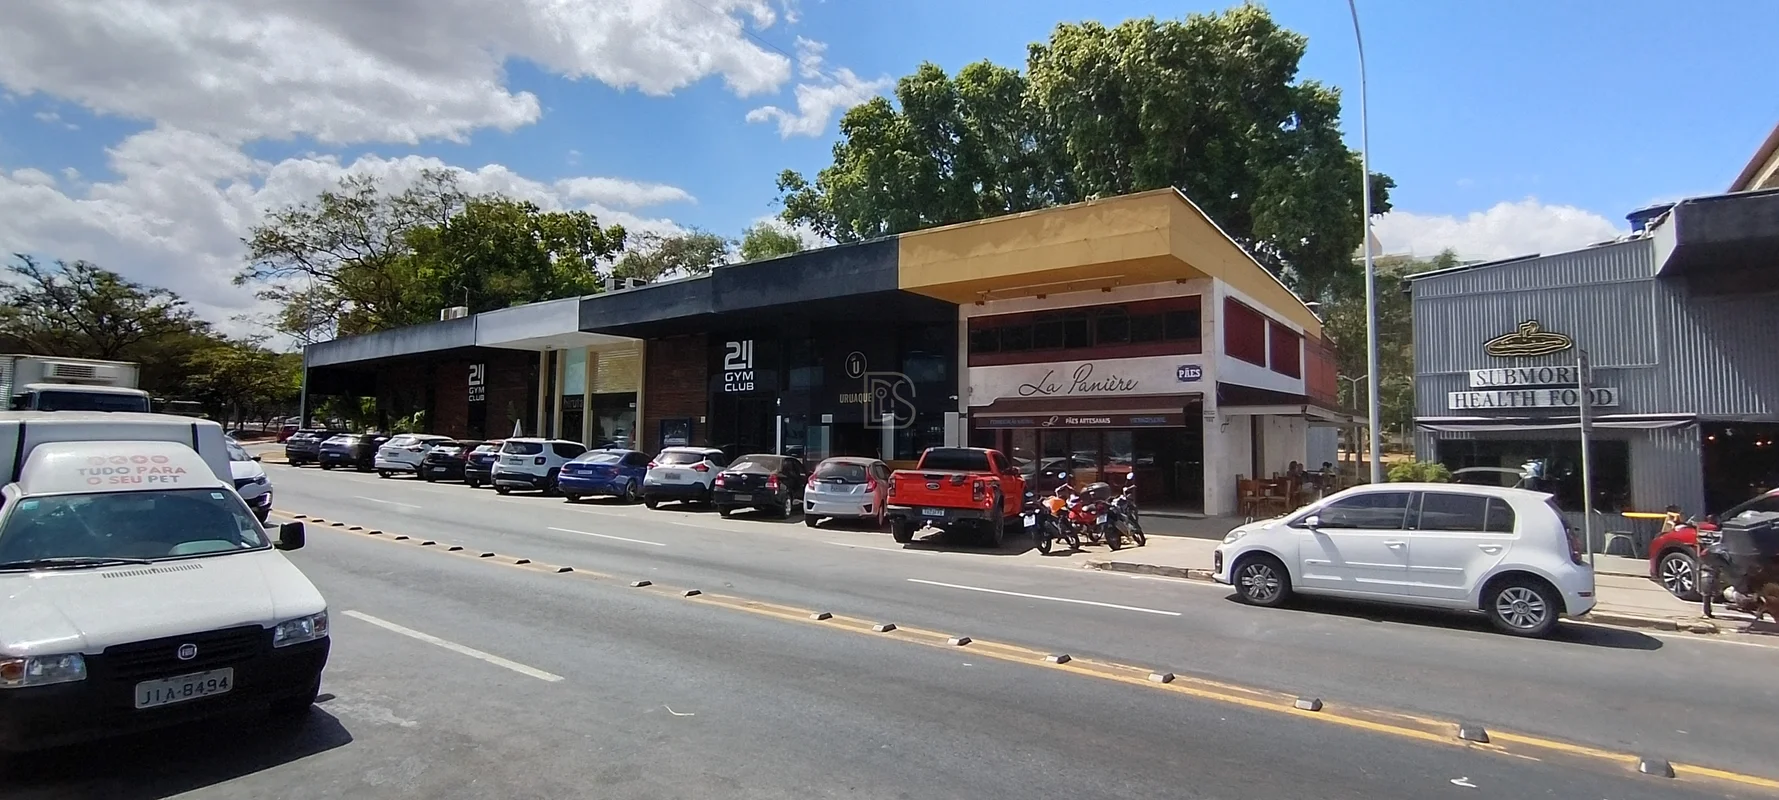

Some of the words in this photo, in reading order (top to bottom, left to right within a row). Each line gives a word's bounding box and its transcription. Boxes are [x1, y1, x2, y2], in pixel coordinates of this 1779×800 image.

[724, 371, 754, 382] GYM
[1178, 367, 1201, 378] PÃES
[1018, 369, 1063, 397] La
[1067, 362, 1140, 394] Panière
[468, 386, 485, 394] GYM
[724, 381, 755, 392] CLUB
[468, 394, 485, 402] CLUB
[839, 392, 872, 404] URUAQUE
[1454, 390, 1536, 408] HEALTH
[1079, 416, 1112, 425] ARTESANAIS
[78, 466, 130, 476] TUDO
[136, 465, 187, 474] PARA
[86, 476, 103, 486] O
[109, 475, 142, 485] SEU
[148, 475, 180, 483] PET
